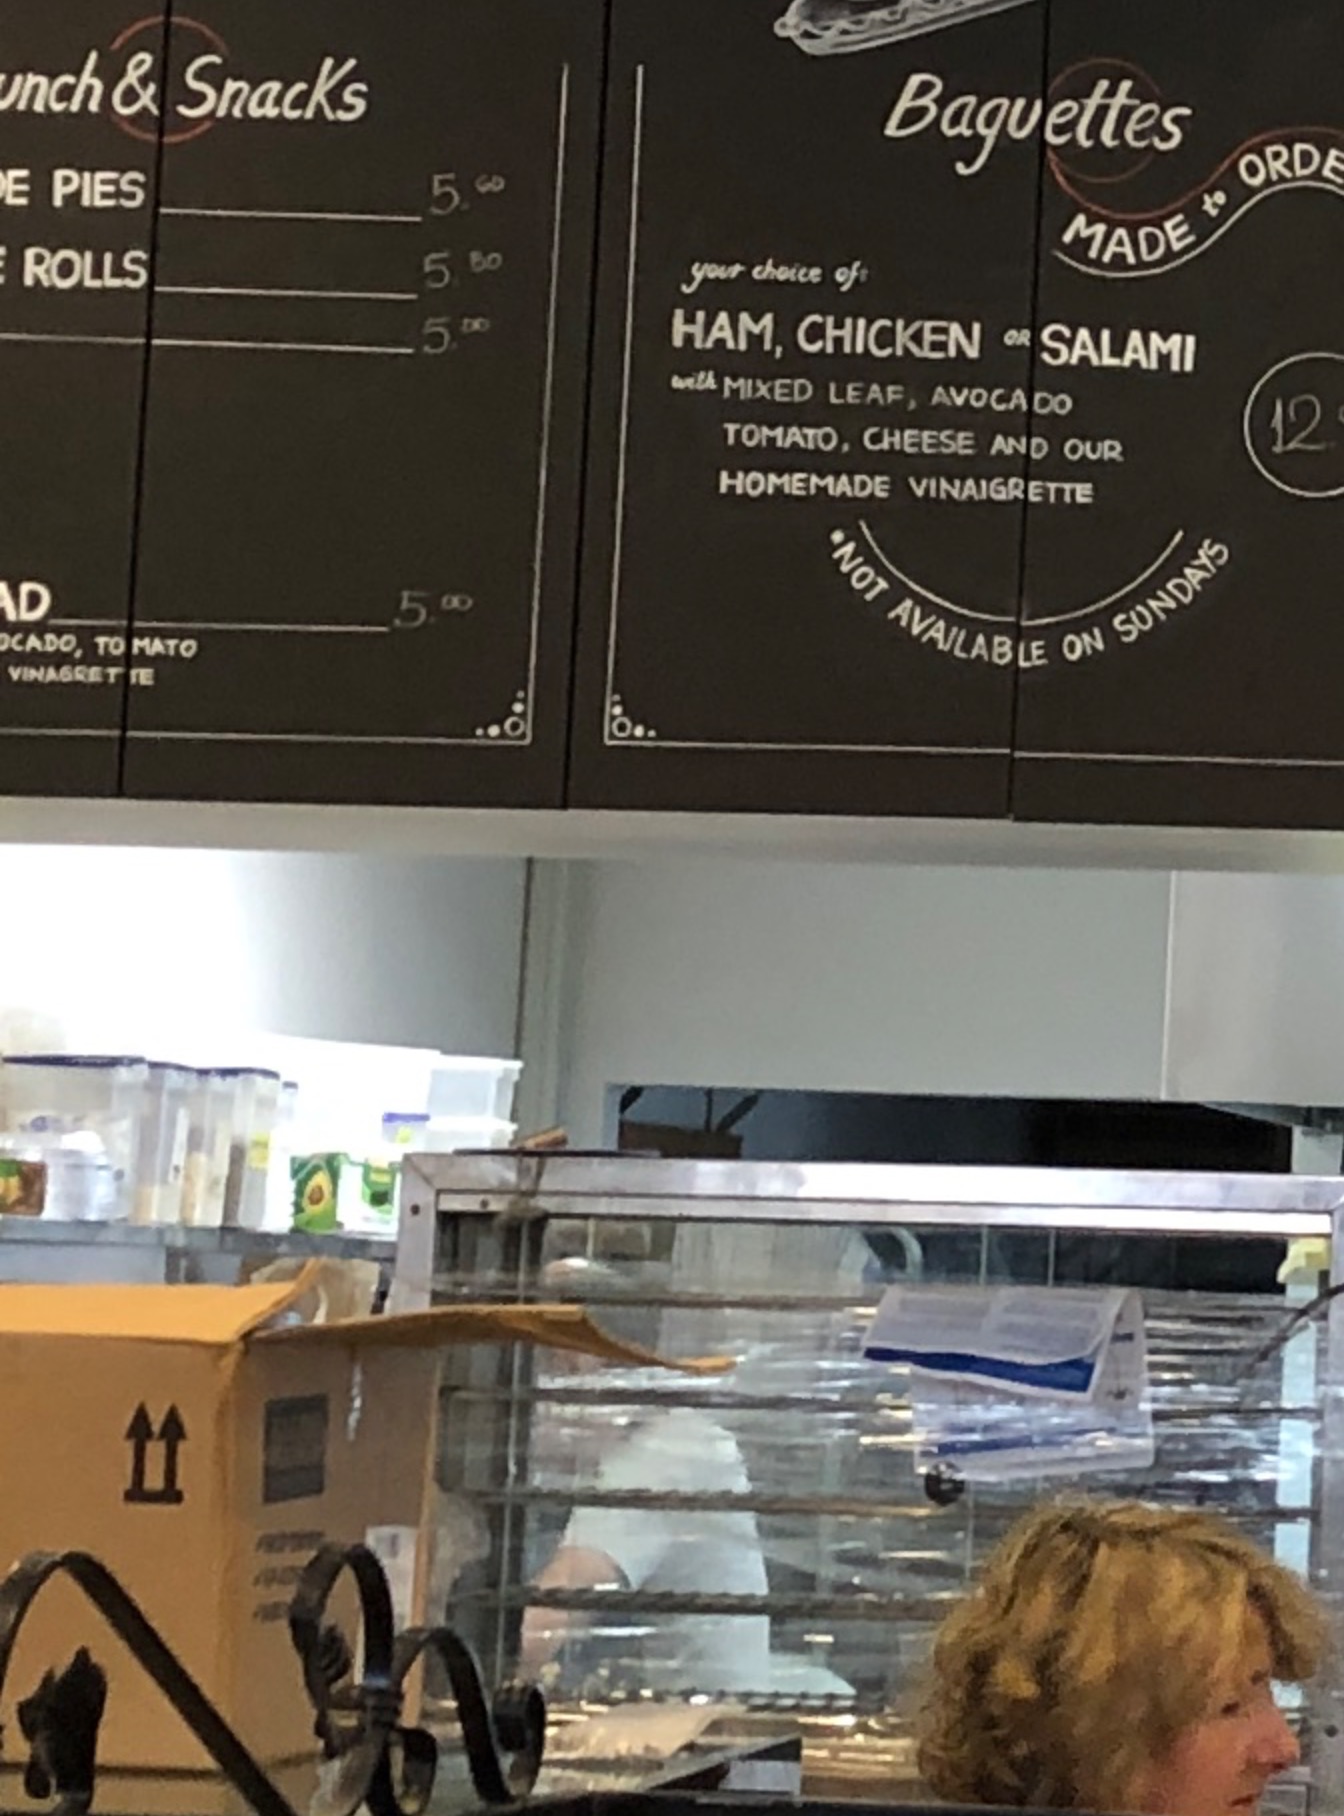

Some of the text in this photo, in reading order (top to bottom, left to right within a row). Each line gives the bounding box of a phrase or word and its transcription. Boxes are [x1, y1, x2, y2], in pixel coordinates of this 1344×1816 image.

[111, 51, 160, 117] &
[883, 72, 1192, 175] Baguettes
[0, 168, 147, 208] E PIES
[1062, 213, 1196, 265] MADE
[1202, 190, 1227, 217] to
[23, 247, 148, 288] ROLLS
[681, 261, 745, 294] your
[752, 258, 822, 283] choice
[672, 308, 1197, 372] HAM, CHICKEN OR SALAMI
[671, 371, 1073, 415] with MIXED LEAF, AVOCADO
[723, 422, 1124, 462] TOMATO, CHEESE AND OUR
[719, 470, 1094, 504] HOMEMADE VINAIGRETTE
[888, 598, 1048, 667] AVAILABLE
[1063, 627, 1105, 662] ON
[1112, 538, 1229, 644] SUNDAYS
[94, 636, 198, 658] TOMATO
